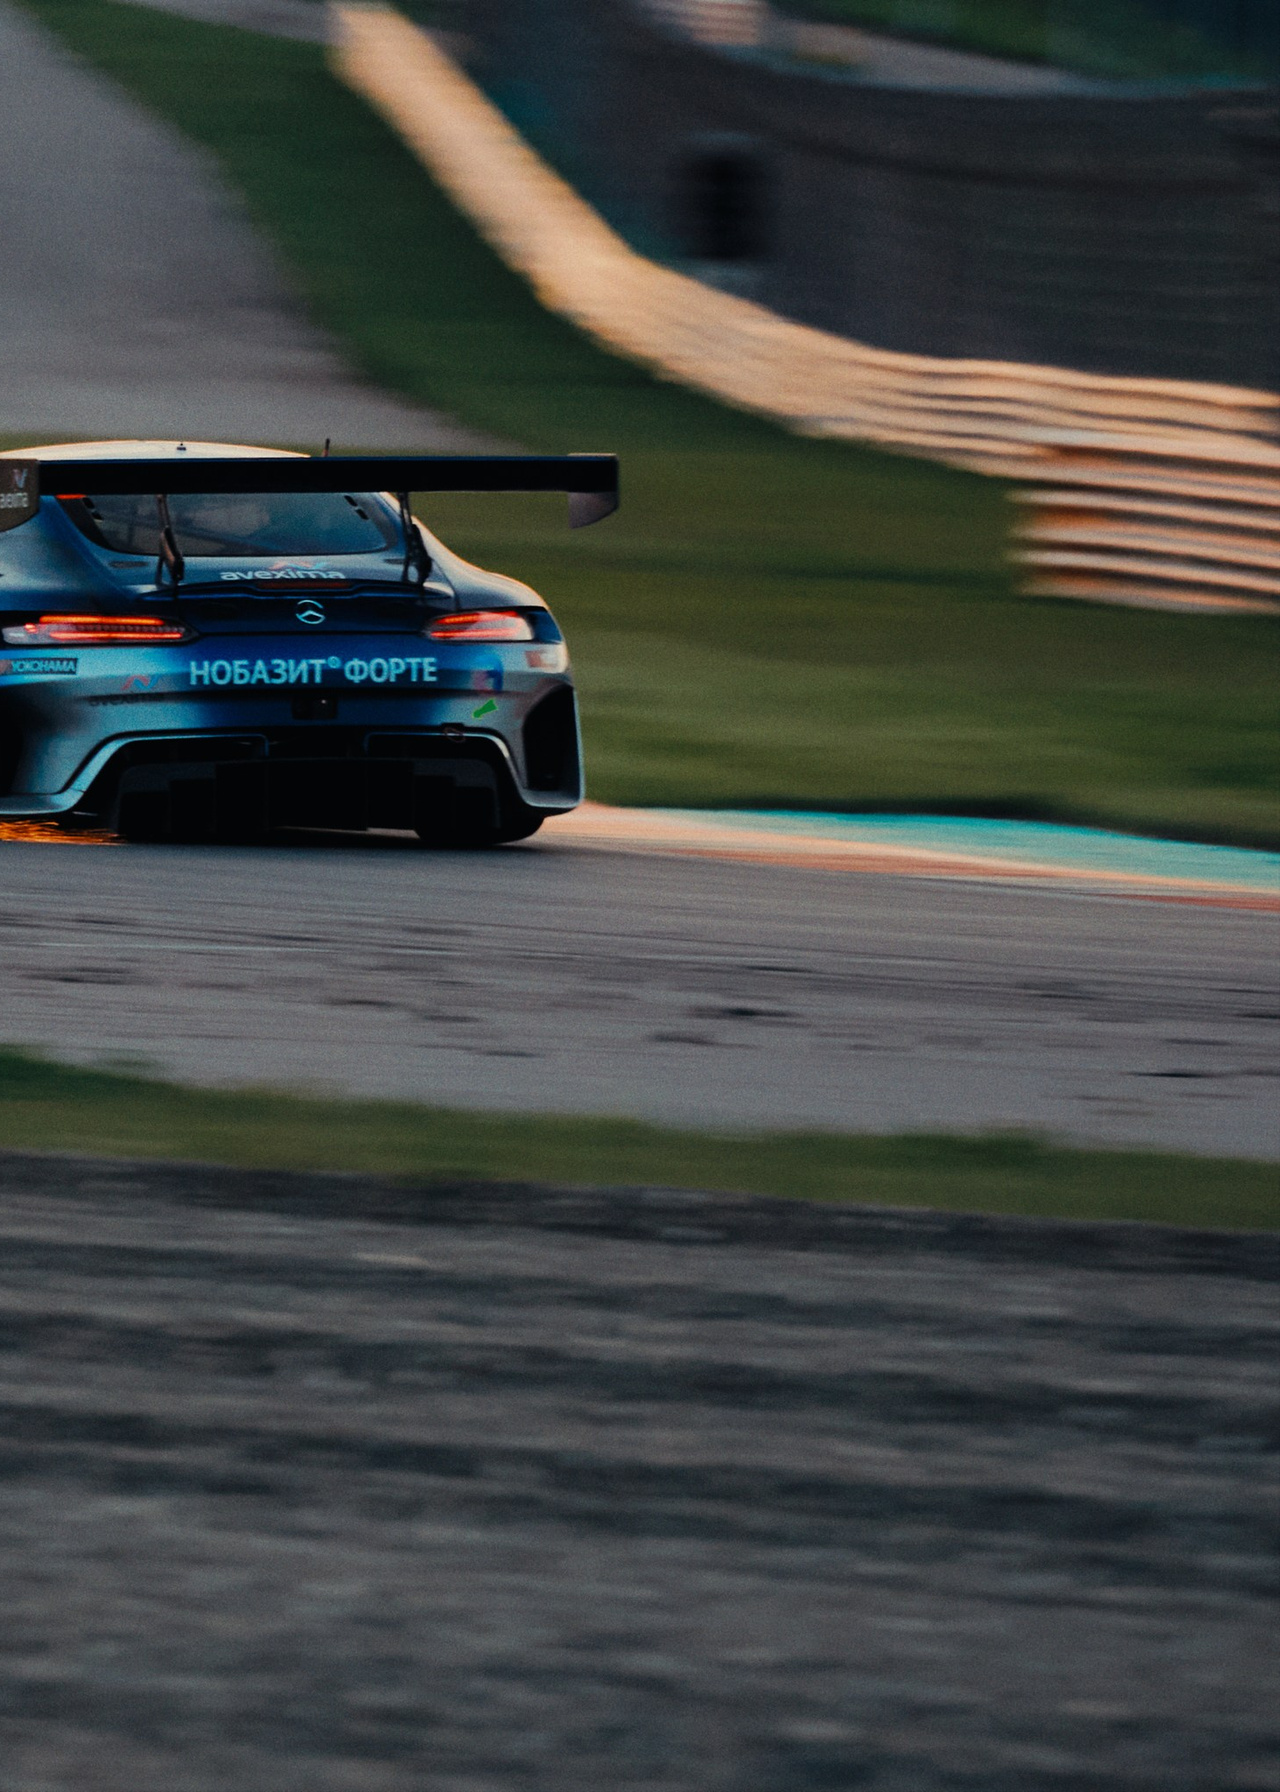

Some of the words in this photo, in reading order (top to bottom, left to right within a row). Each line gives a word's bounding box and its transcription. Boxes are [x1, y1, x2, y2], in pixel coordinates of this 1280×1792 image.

[220, 569, 346, 581] avexima
[11, 660, 76, 673] YOKOHAMA
[343, 657, 438, 683] ФОРТЕ
